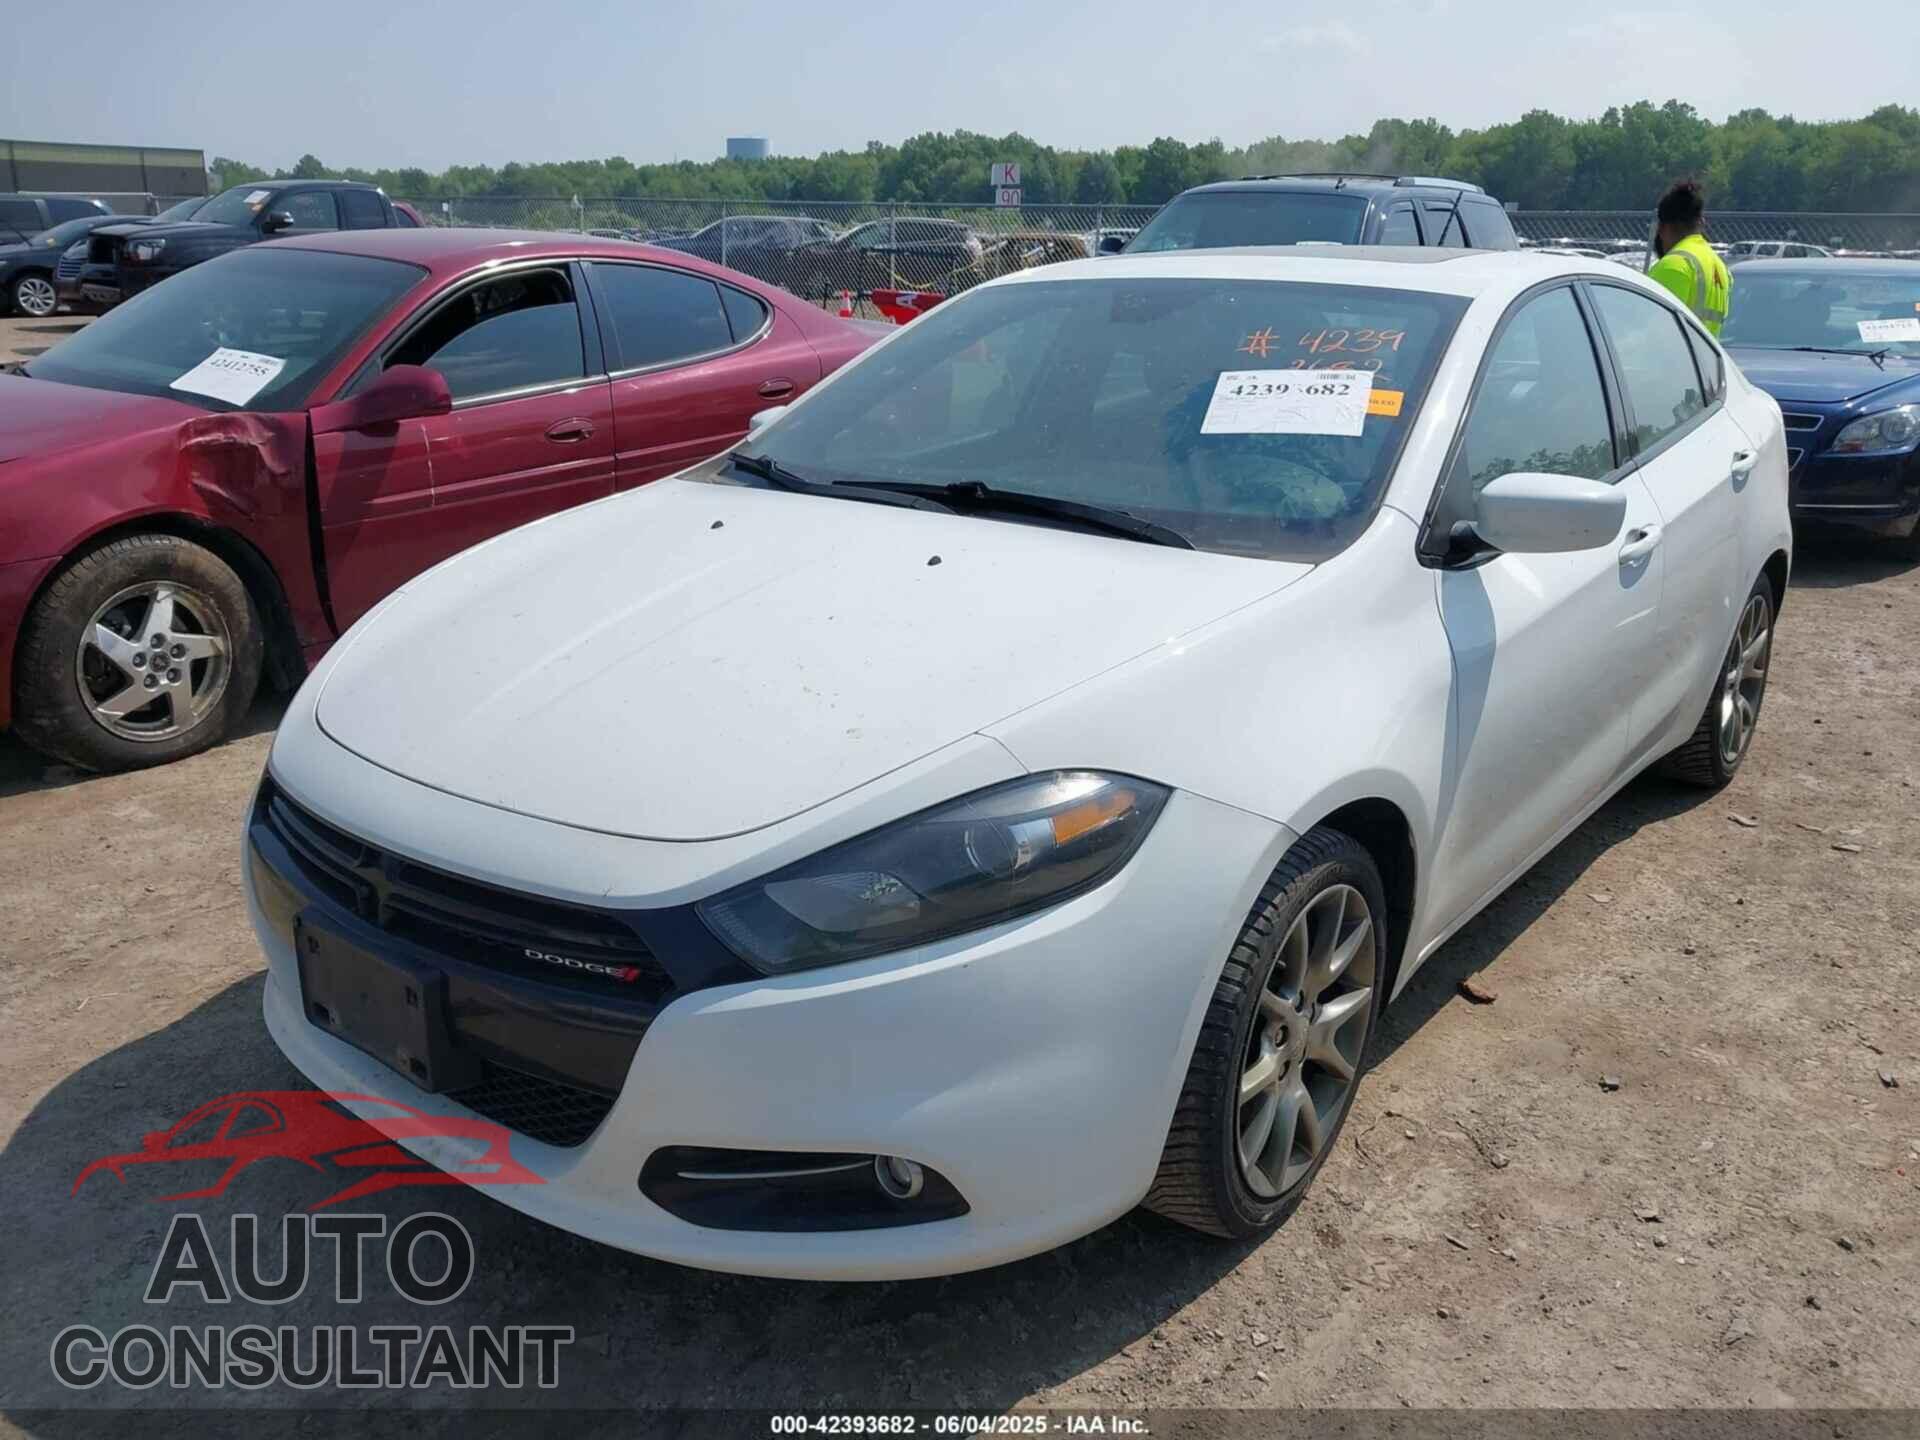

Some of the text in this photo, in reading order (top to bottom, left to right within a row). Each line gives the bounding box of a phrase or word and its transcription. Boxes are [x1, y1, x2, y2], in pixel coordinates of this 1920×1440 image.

[1004, 163, 1017, 184] K
[1299, 327, 1406, 354] 4239
[1229, 383, 1352, 397] 4239682
[524, 948, 625, 978] DODGE
